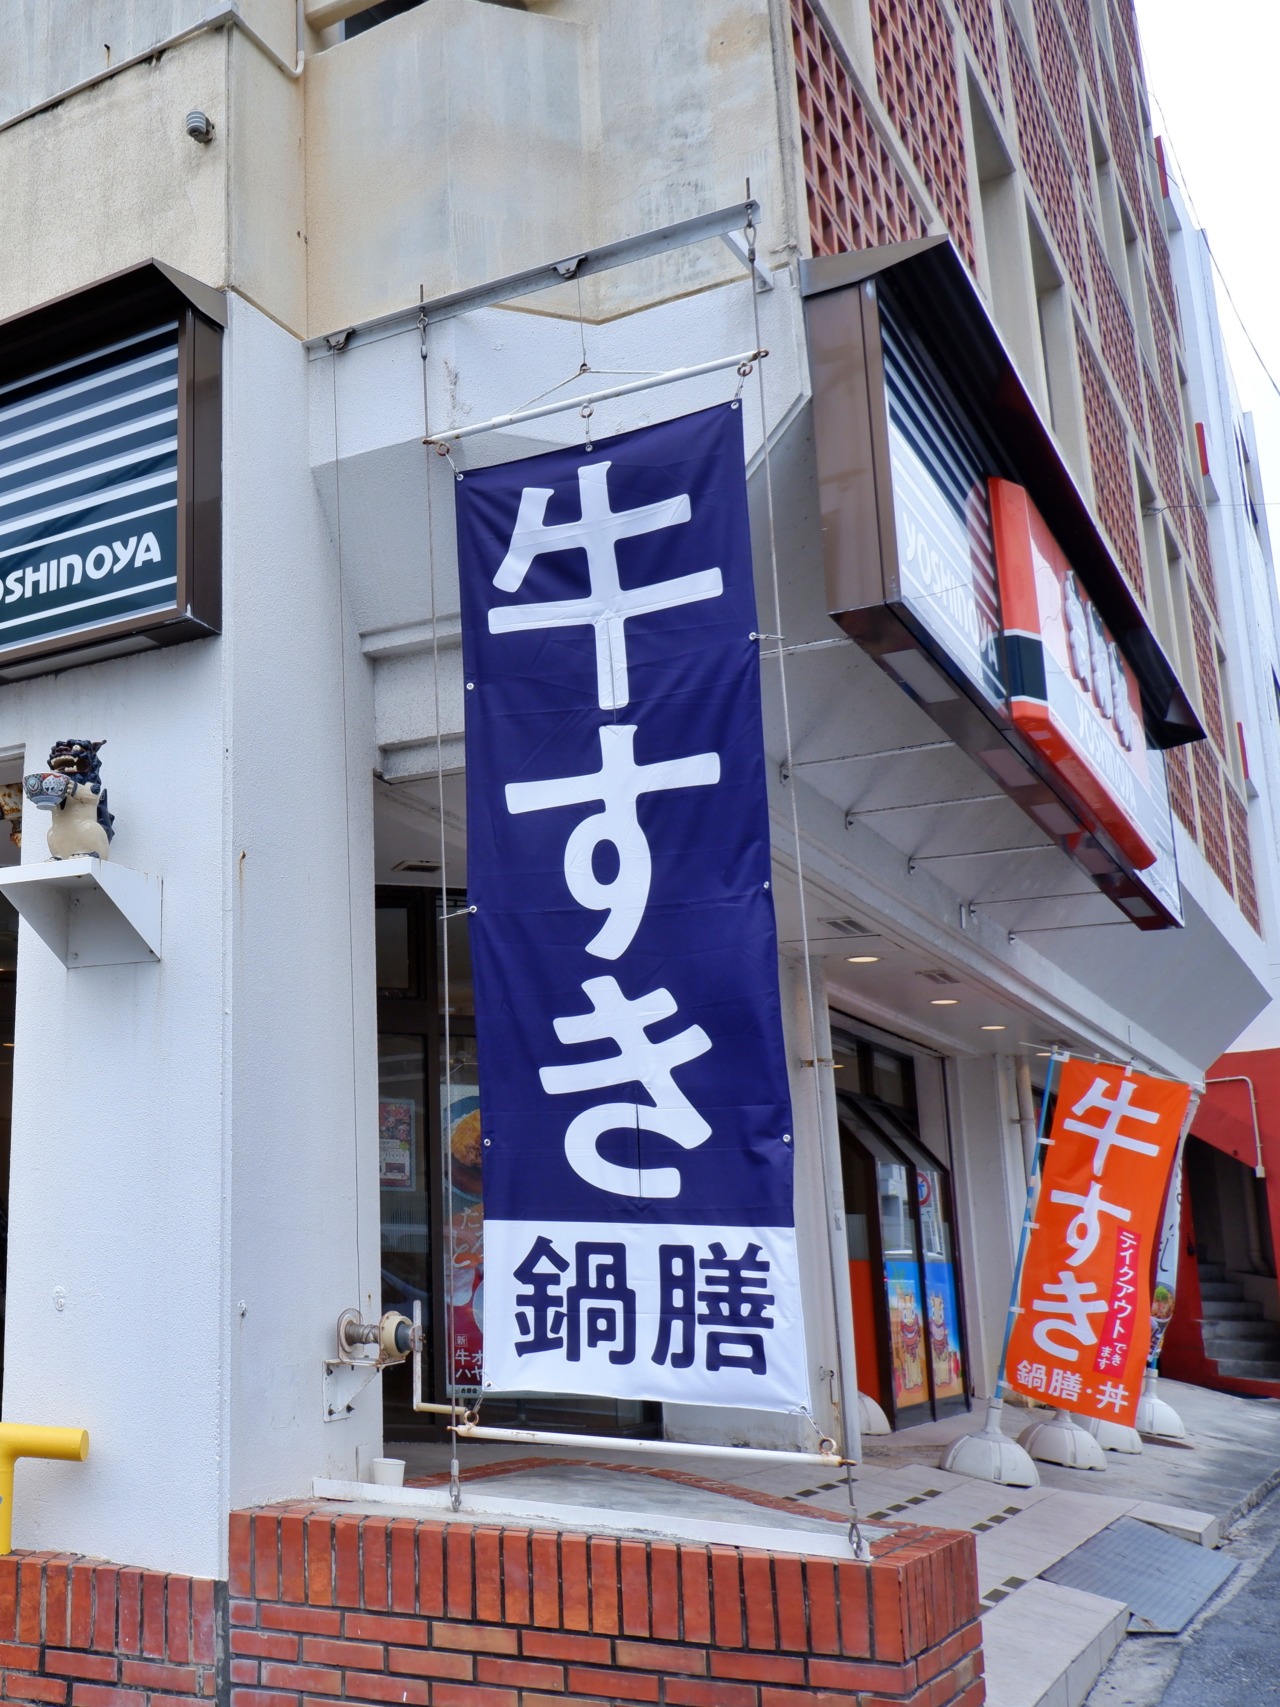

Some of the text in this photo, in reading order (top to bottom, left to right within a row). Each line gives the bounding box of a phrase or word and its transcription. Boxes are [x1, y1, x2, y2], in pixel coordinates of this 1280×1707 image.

[902, 516, 999, 674] YOSHINOYA
[487, 460, 723, 1199] 牛すき
[512, 1235, 774, 1376] 鍋膳
[1032, 1077, 1160, 1362] 牛すき
